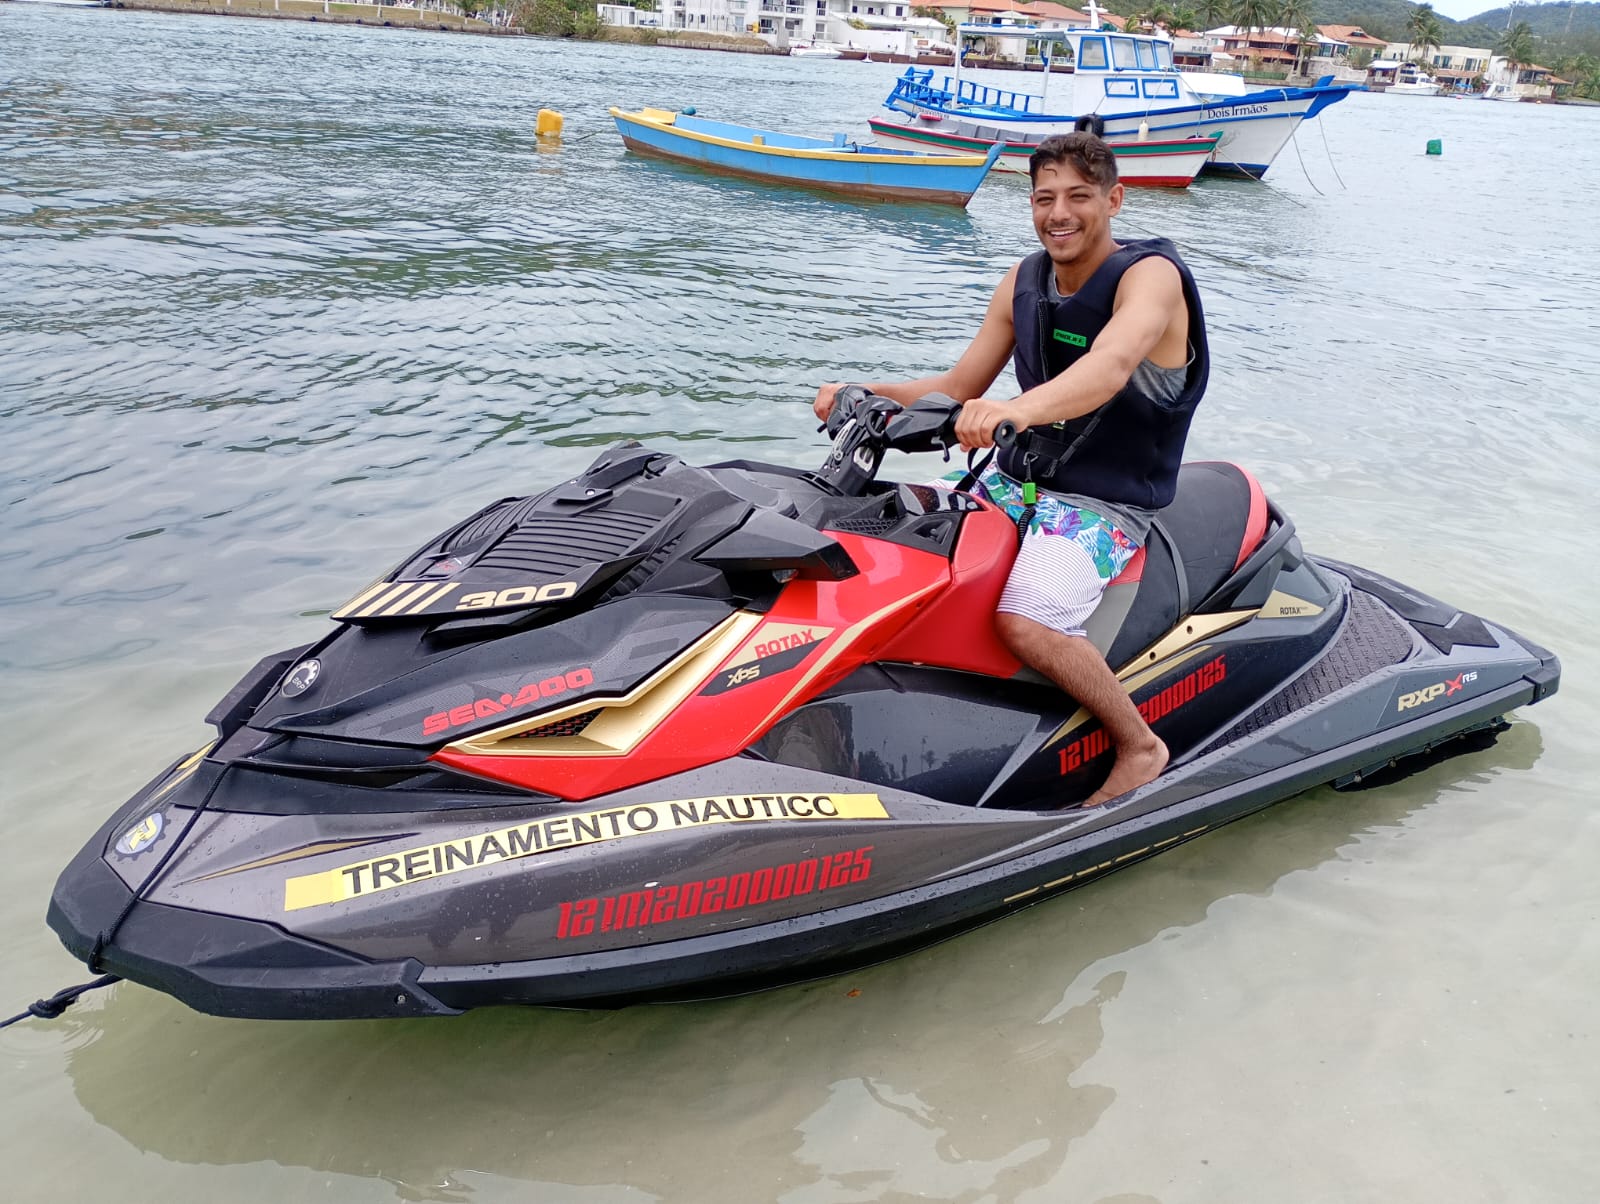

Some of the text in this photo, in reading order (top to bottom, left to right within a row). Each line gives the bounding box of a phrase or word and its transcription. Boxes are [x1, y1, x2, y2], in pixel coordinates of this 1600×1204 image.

[1207, 104, 1268, 119] Dois Irmãos
[455, 581, 578, 611] 300
[1280, 606, 1301, 615] ROTAX
[754, 628, 815, 660] ROTAX
[292, 676, 306, 690] BRP
[726, 664, 760, 688] XPS
[342, 796, 839, 894] TREINAMENTO NAUTICO
